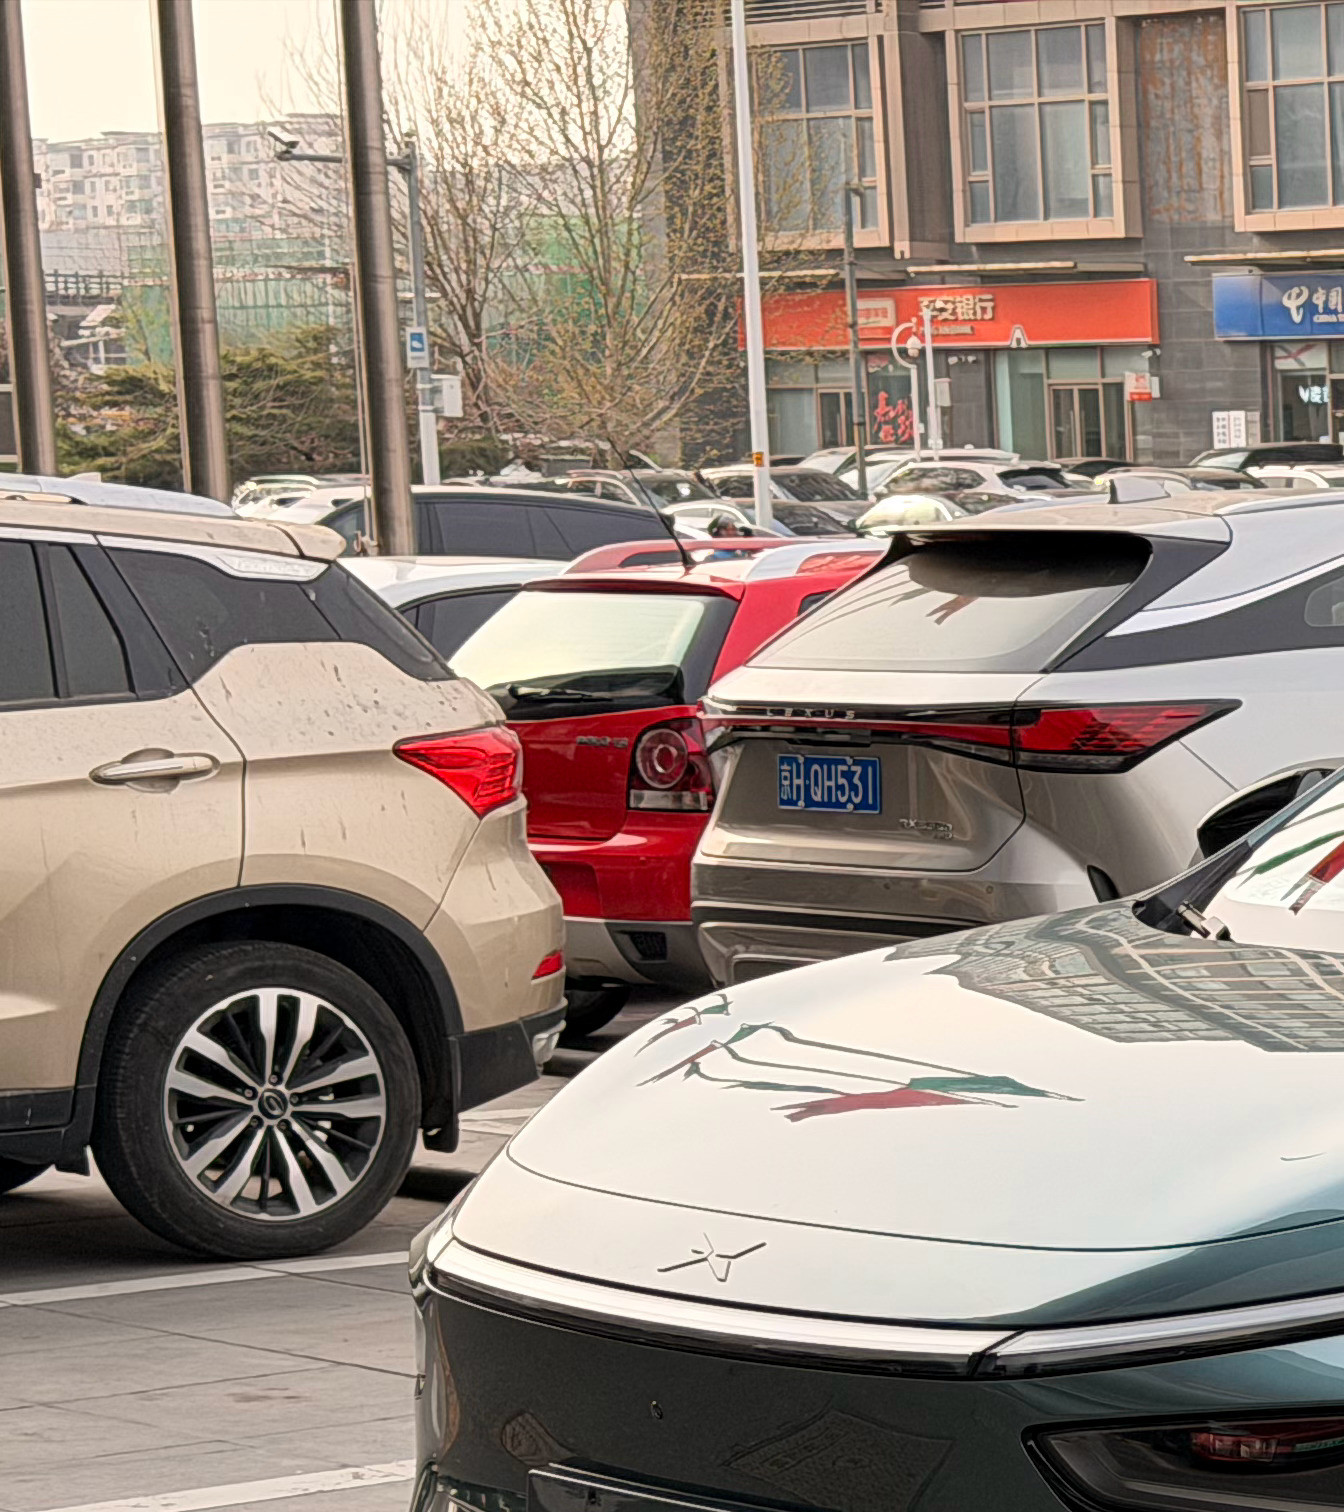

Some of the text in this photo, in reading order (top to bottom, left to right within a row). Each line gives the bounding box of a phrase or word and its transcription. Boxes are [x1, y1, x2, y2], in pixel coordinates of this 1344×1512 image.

[917, 294, 996, 320] 平安银行
[766, 707, 856, 720] LEXUS
